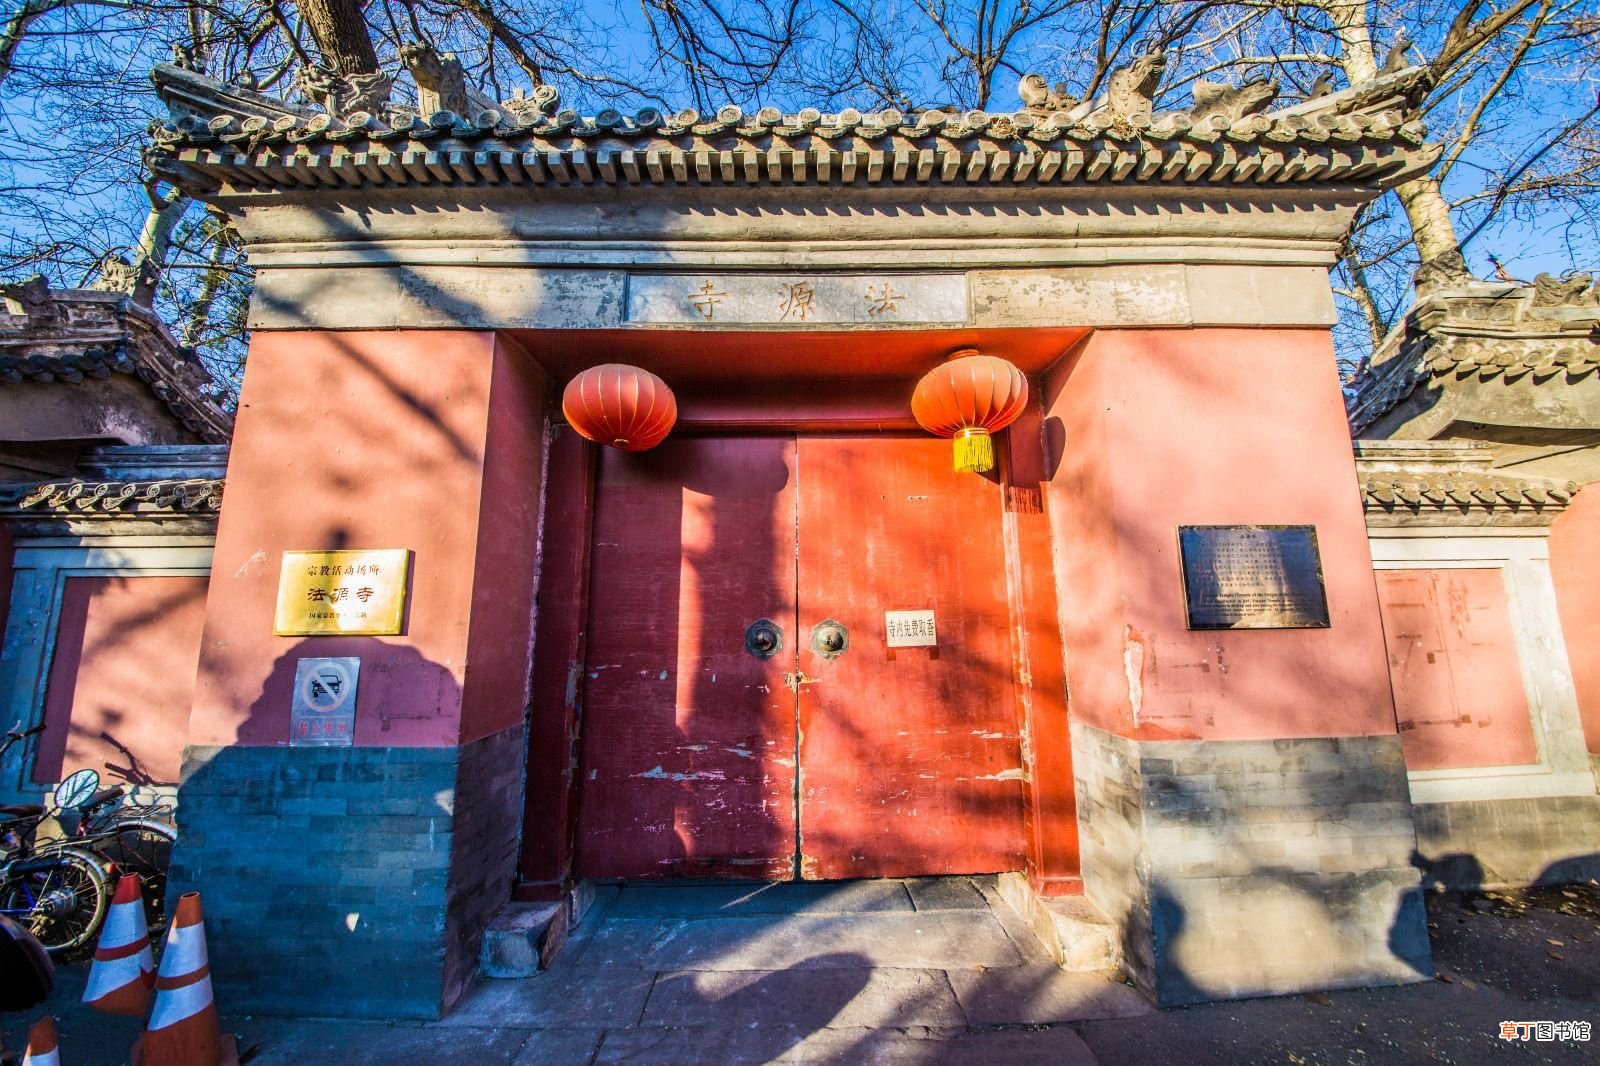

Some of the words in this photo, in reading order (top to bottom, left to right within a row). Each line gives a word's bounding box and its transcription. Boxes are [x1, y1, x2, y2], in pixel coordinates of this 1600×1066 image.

[307, 565, 381, 576] 宗教活动场所
[307, 586, 374, 602] 法源寺
[888, 618, 934, 637] 寺内免费取香
